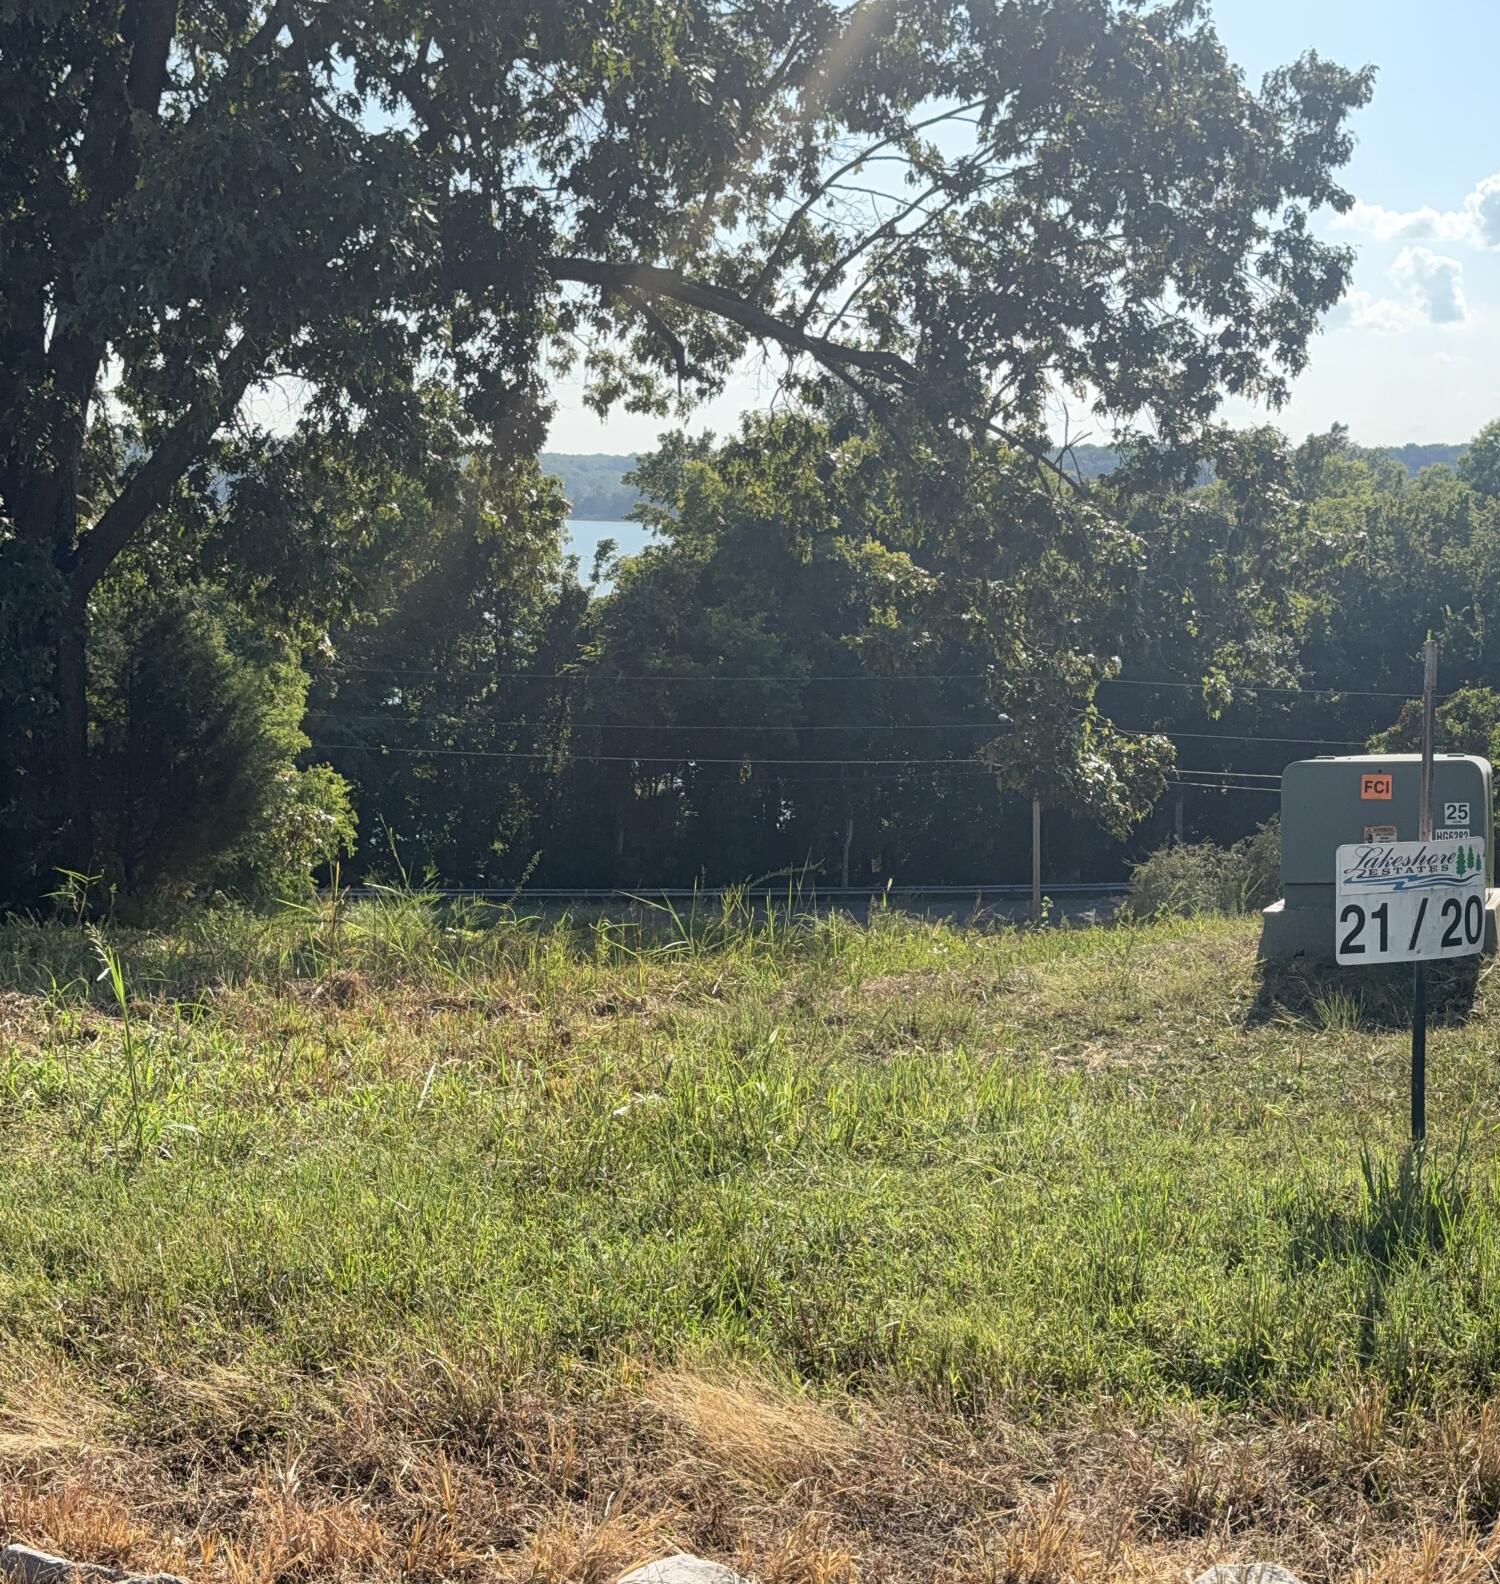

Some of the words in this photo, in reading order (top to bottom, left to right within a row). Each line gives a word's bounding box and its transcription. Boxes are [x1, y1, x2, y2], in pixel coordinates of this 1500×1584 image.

[1364, 780, 1389, 794] FCI
[1446, 804, 1468, 820] 25
[1344, 845, 1456, 878] Lakeshore
[1368, 864, 1449, 876] ESTATES
[1339, 903, 1389, 955] 21
[1408, 897, 1429, 950] /
[1440, 894, 1483, 948] 20
